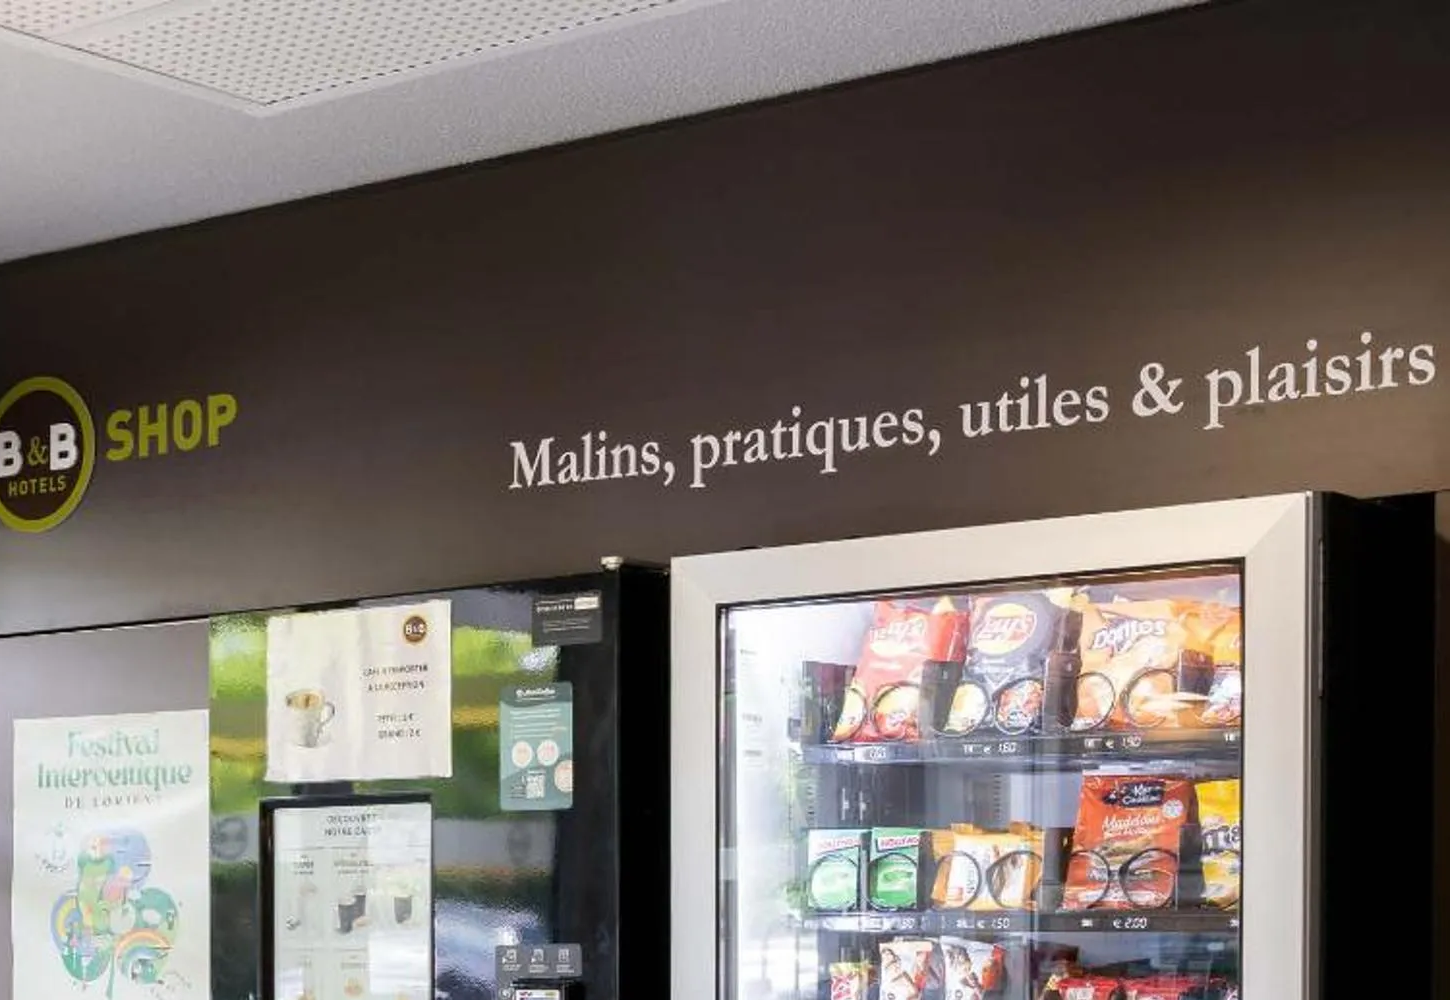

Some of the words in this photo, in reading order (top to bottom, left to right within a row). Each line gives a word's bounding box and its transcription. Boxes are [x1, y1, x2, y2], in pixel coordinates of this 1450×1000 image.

[508, 430, 676, 489] Malins,
[689, 405, 942, 488] pratiques,
[959, 373, 1110, 438] utiles
[1131, 361, 1185, 417] &
[1202, 331, 1437, 430] plaisirs
[106, 393, 238, 461] SHOP
[8, 475, 67, 497] HOTELS
[1094, 618, 1168, 650] Doritos
[66, 728, 161, 759] Festival
